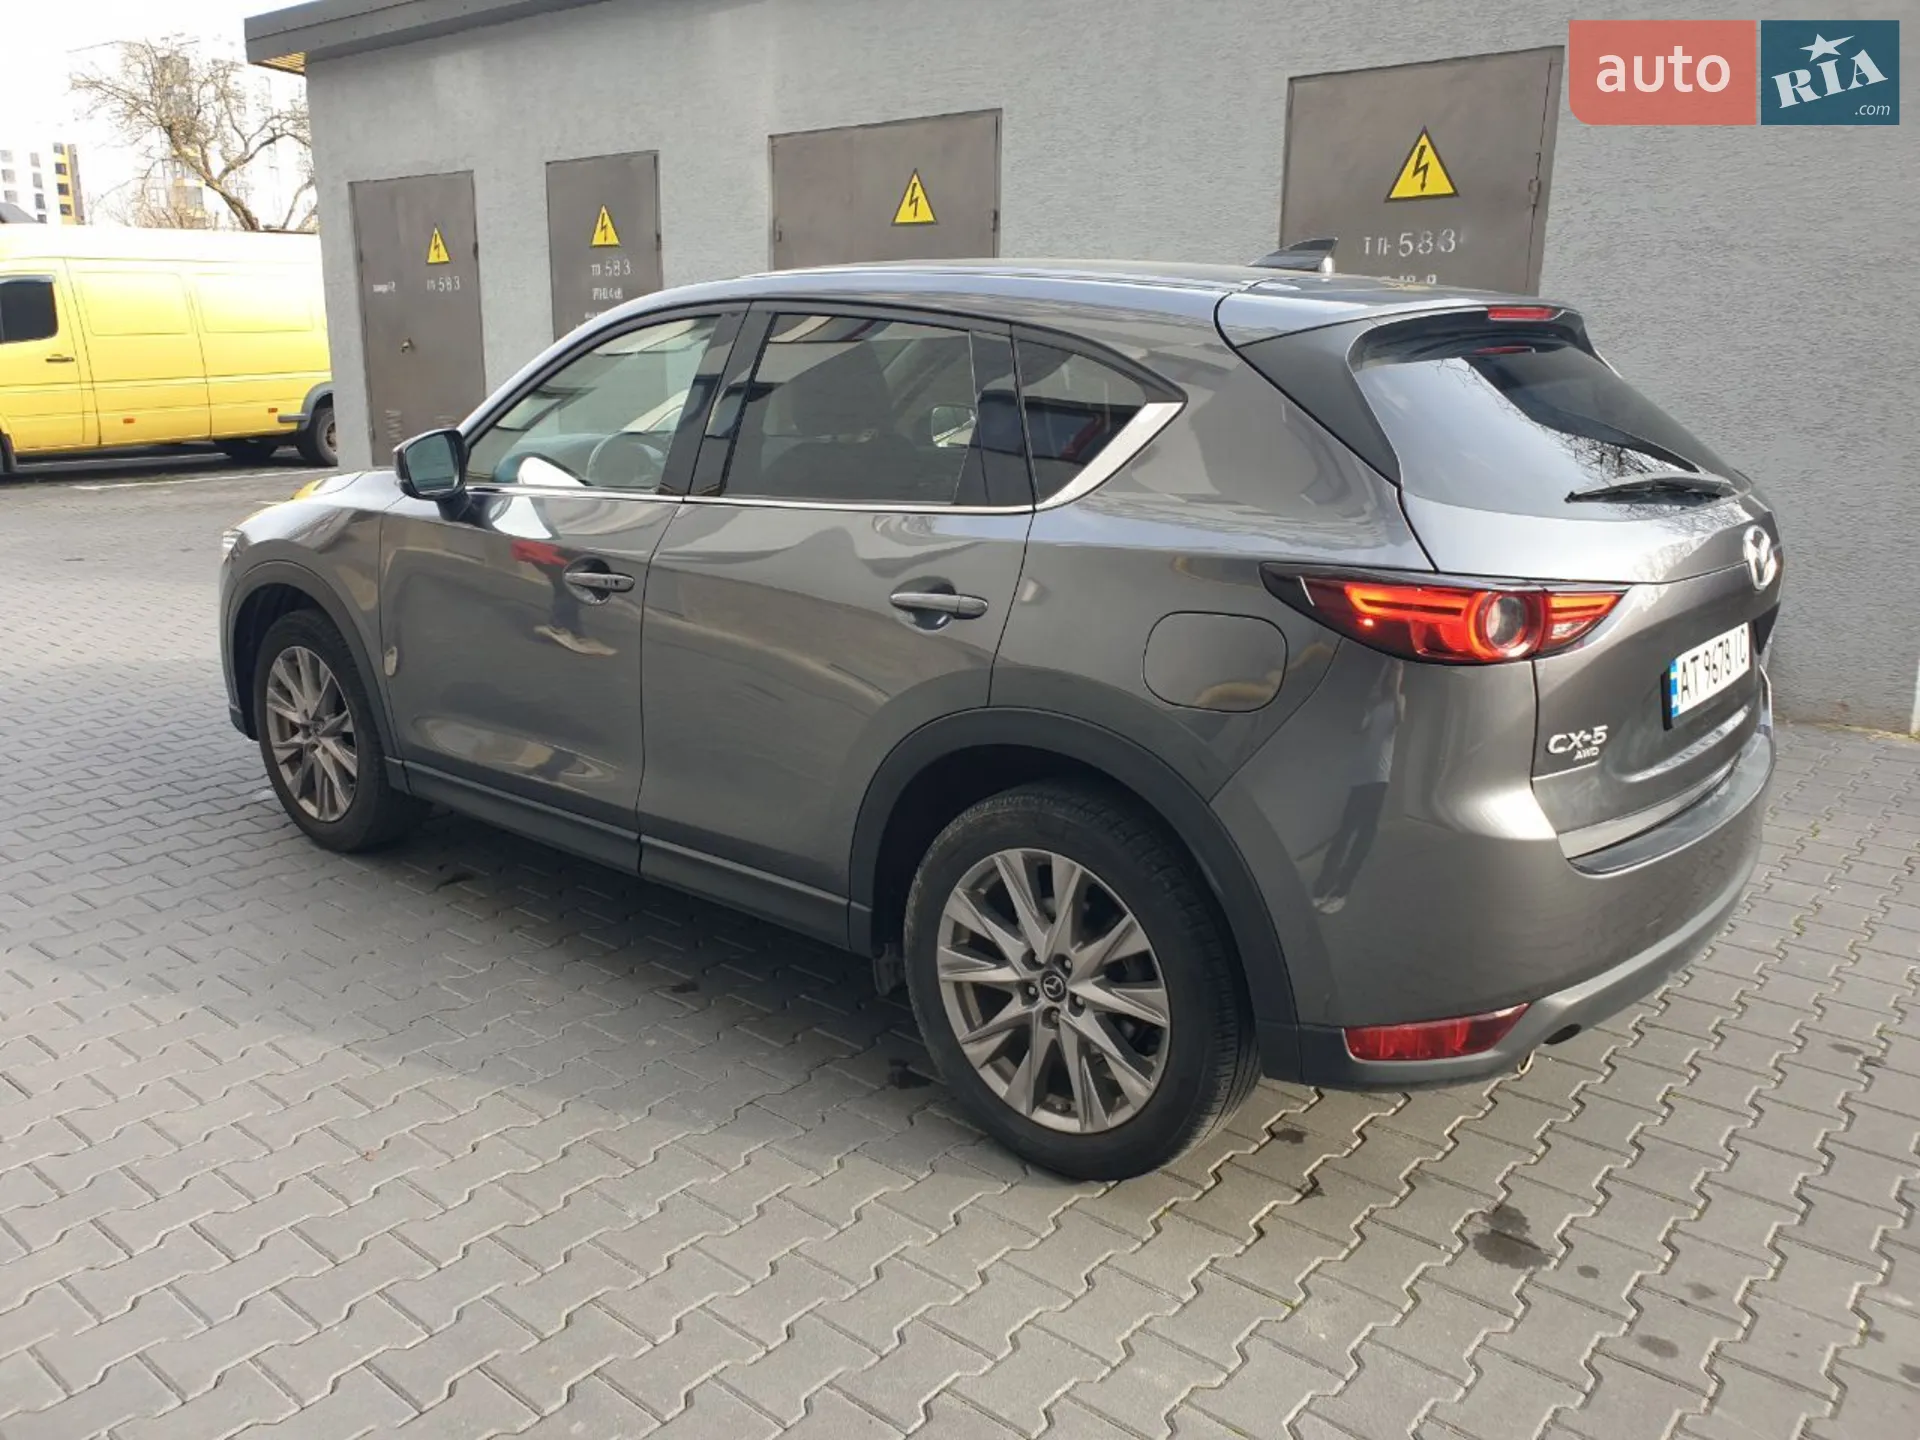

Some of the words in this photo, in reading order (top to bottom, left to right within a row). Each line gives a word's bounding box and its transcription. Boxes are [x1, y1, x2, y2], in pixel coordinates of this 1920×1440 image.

[1398, 228, 1456, 257] 583
[605, 258, 631, 276] 583
[438, 275, 460, 292] 583
[1548, 724, 1608, 754] CX-5
[1573, 746, 1600, 761] AWD
